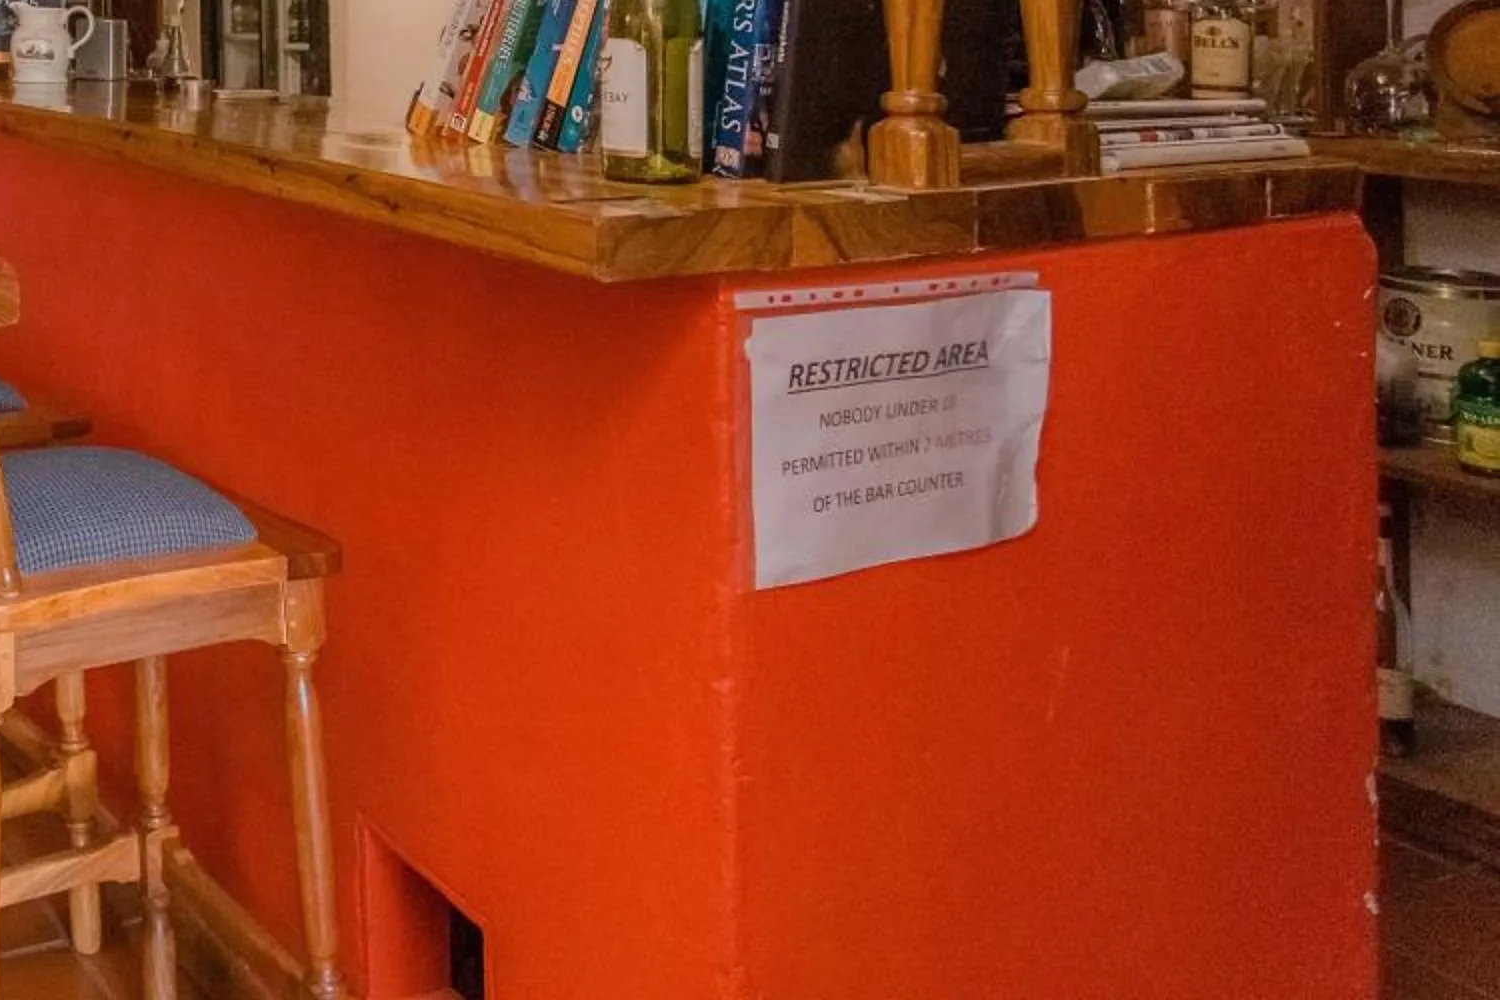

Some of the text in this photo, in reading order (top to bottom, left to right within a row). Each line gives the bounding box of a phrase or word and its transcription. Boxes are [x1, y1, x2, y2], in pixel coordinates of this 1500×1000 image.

[721, 40, 750, 133] ATLAS
[788, 340, 990, 390] RESTRICTED AREA
[1411, 342, 1455, 361] NER
[819, 404, 883, 430] NOBODY
[885, 398, 941, 420] UNDER
[781, 449, 864, 477] PERMITTED
[867, 439, 920, 463] WITHIN
[813, 471, 966, 514] OF THE BAR COUNTER
